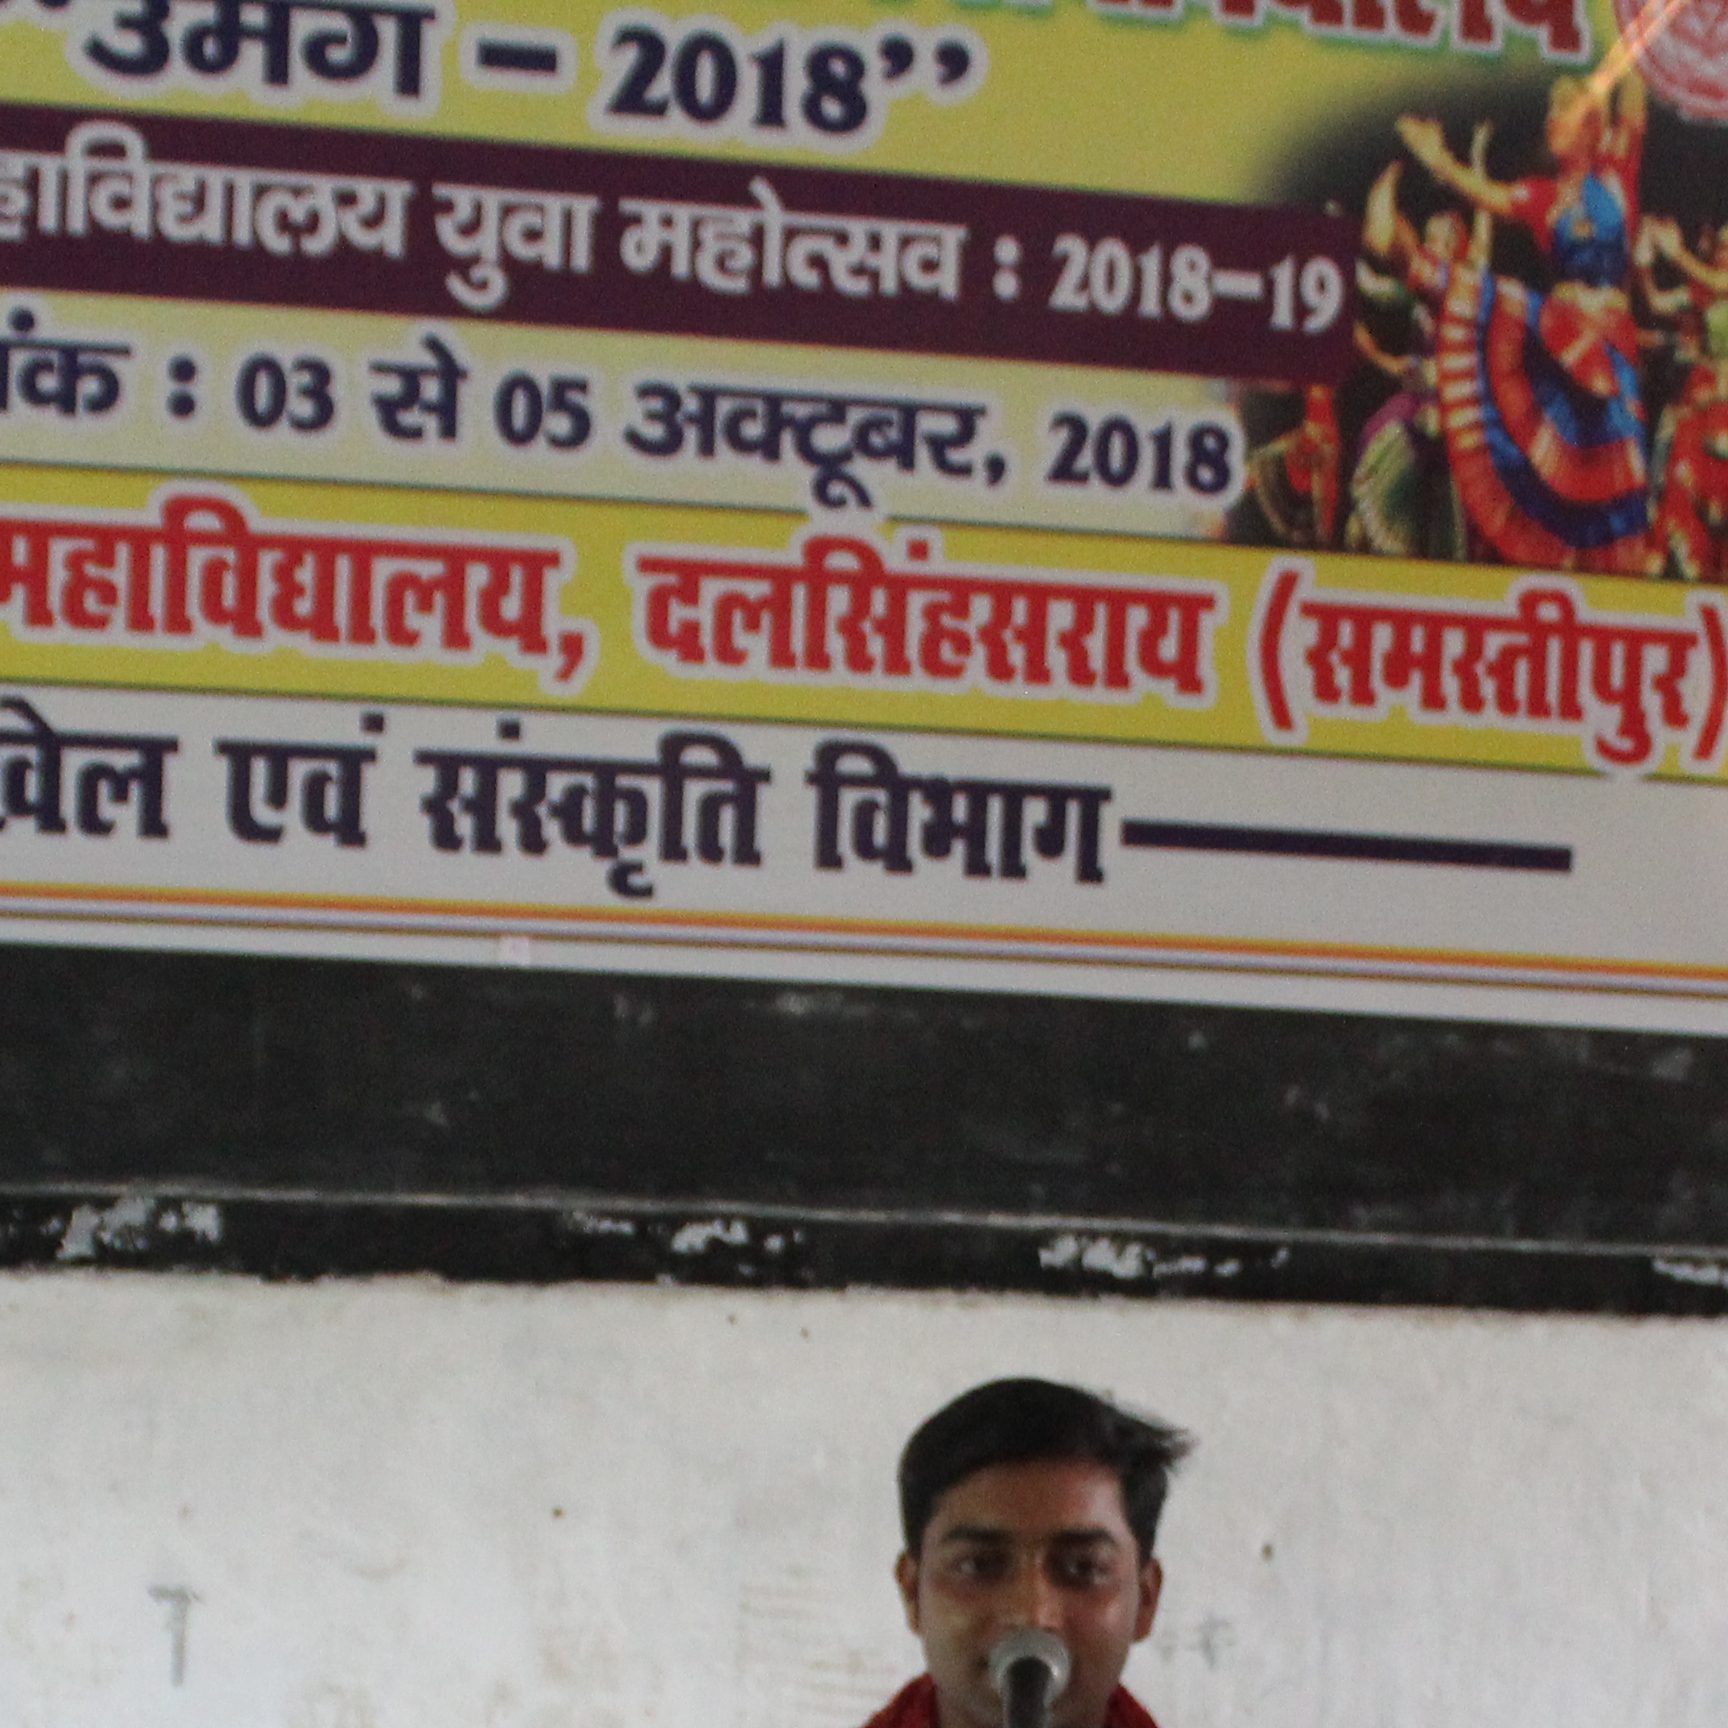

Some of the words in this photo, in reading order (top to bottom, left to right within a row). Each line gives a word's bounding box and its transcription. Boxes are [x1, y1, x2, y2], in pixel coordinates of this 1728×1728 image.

[432, 181, 598, 309] युवा
[618, 176, 968, 300] महोत्सव
[236, 353, 336, 430] 03
[370, 335, 468, 440] से
[496, 372, 591, 447] 05
[624, 382, 1006, 508] अक्टूबर,
[1046, 411, 1233, 495] 2018
[637, 536, 1216, 694] दलसिंहसराय
[216, 712, 385, 848] एवं
[414, 718, 772, 898] संस्कृति
[805, 738, 1113, 883] विभाग
